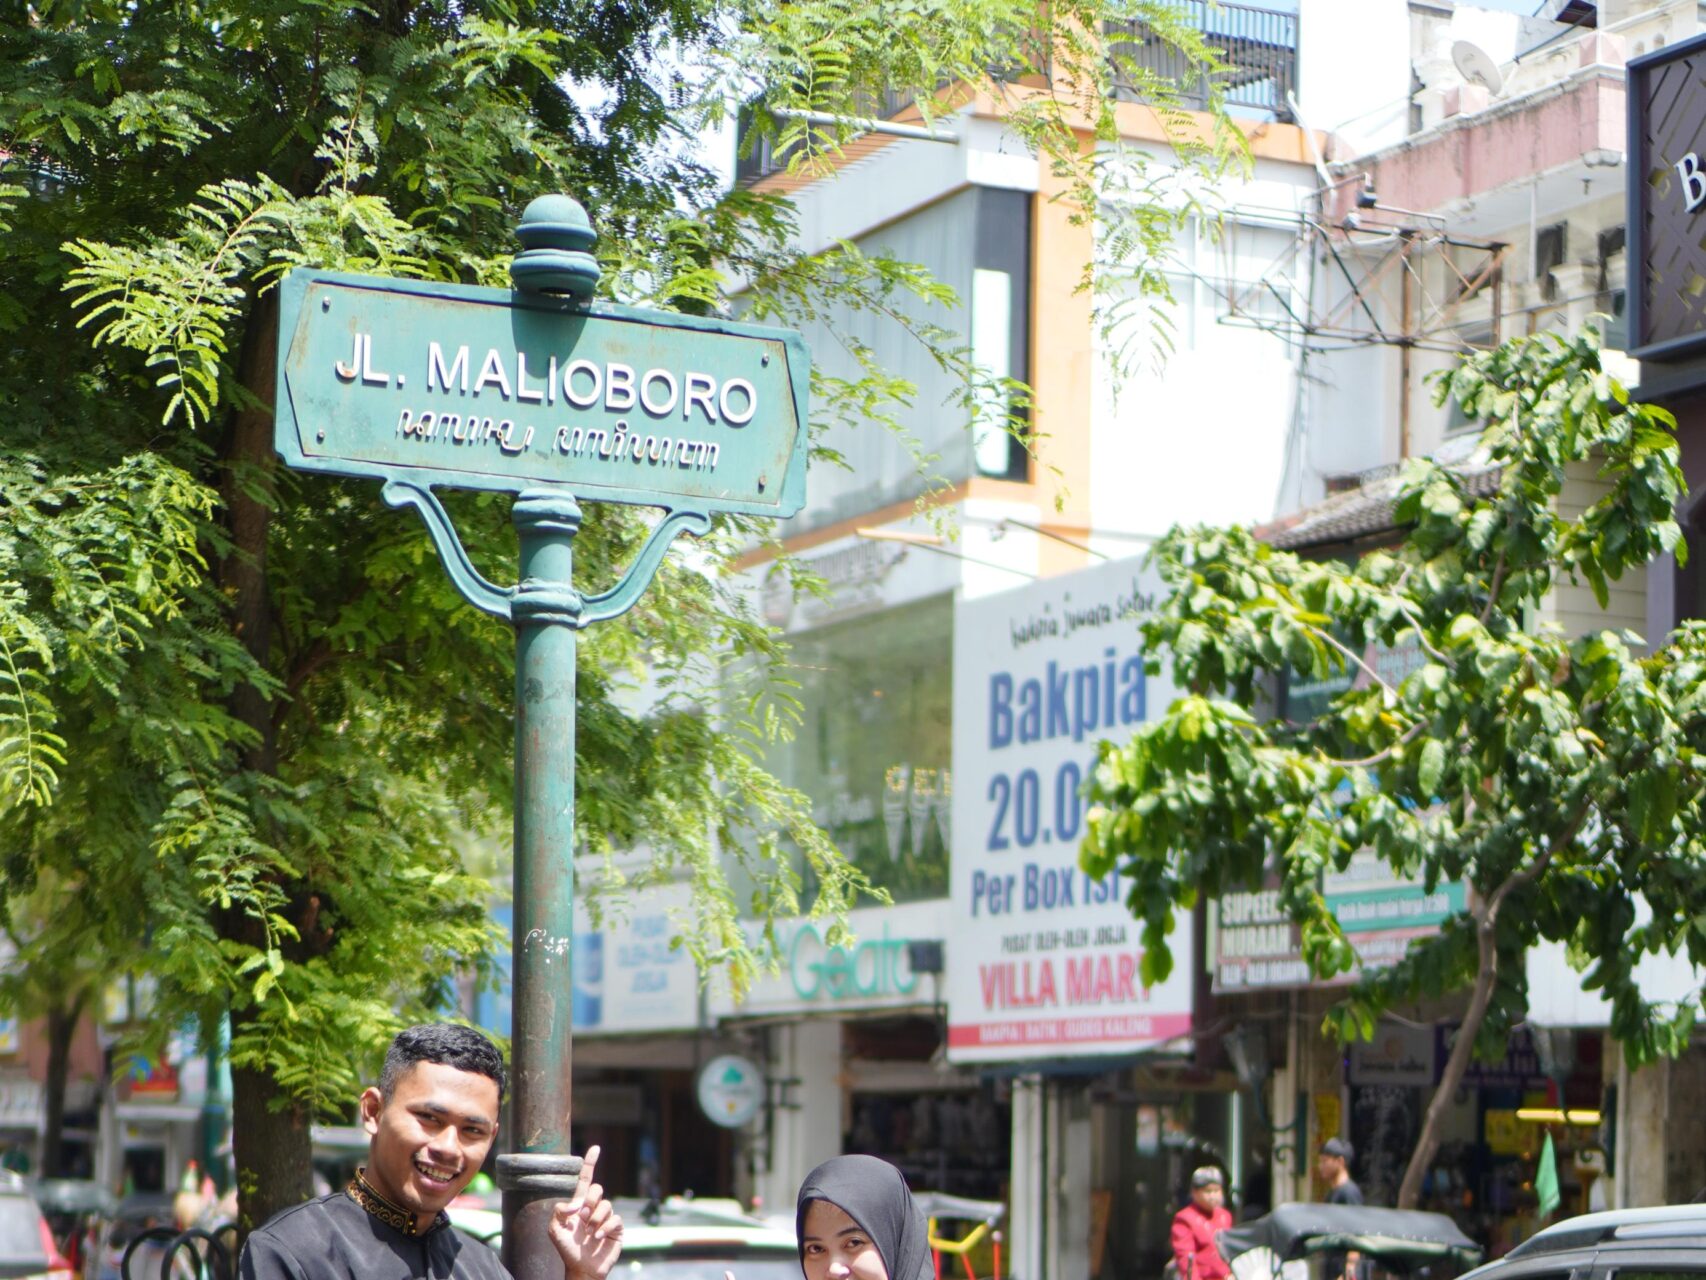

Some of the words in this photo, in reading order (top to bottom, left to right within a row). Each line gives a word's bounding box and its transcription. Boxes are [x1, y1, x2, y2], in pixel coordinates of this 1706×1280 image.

[335, 333, 406, 386] JL.
[427, 341, 759, 425] MALIOBORO
[989, 646, 1147, 750] Bakpia
[987, 757, 1098, 851] 20.0
[972, 869, 1015, 917] Per
[1023, 863, 1074, 911] Box
[979, 960, 1057, 1010] VILLA
